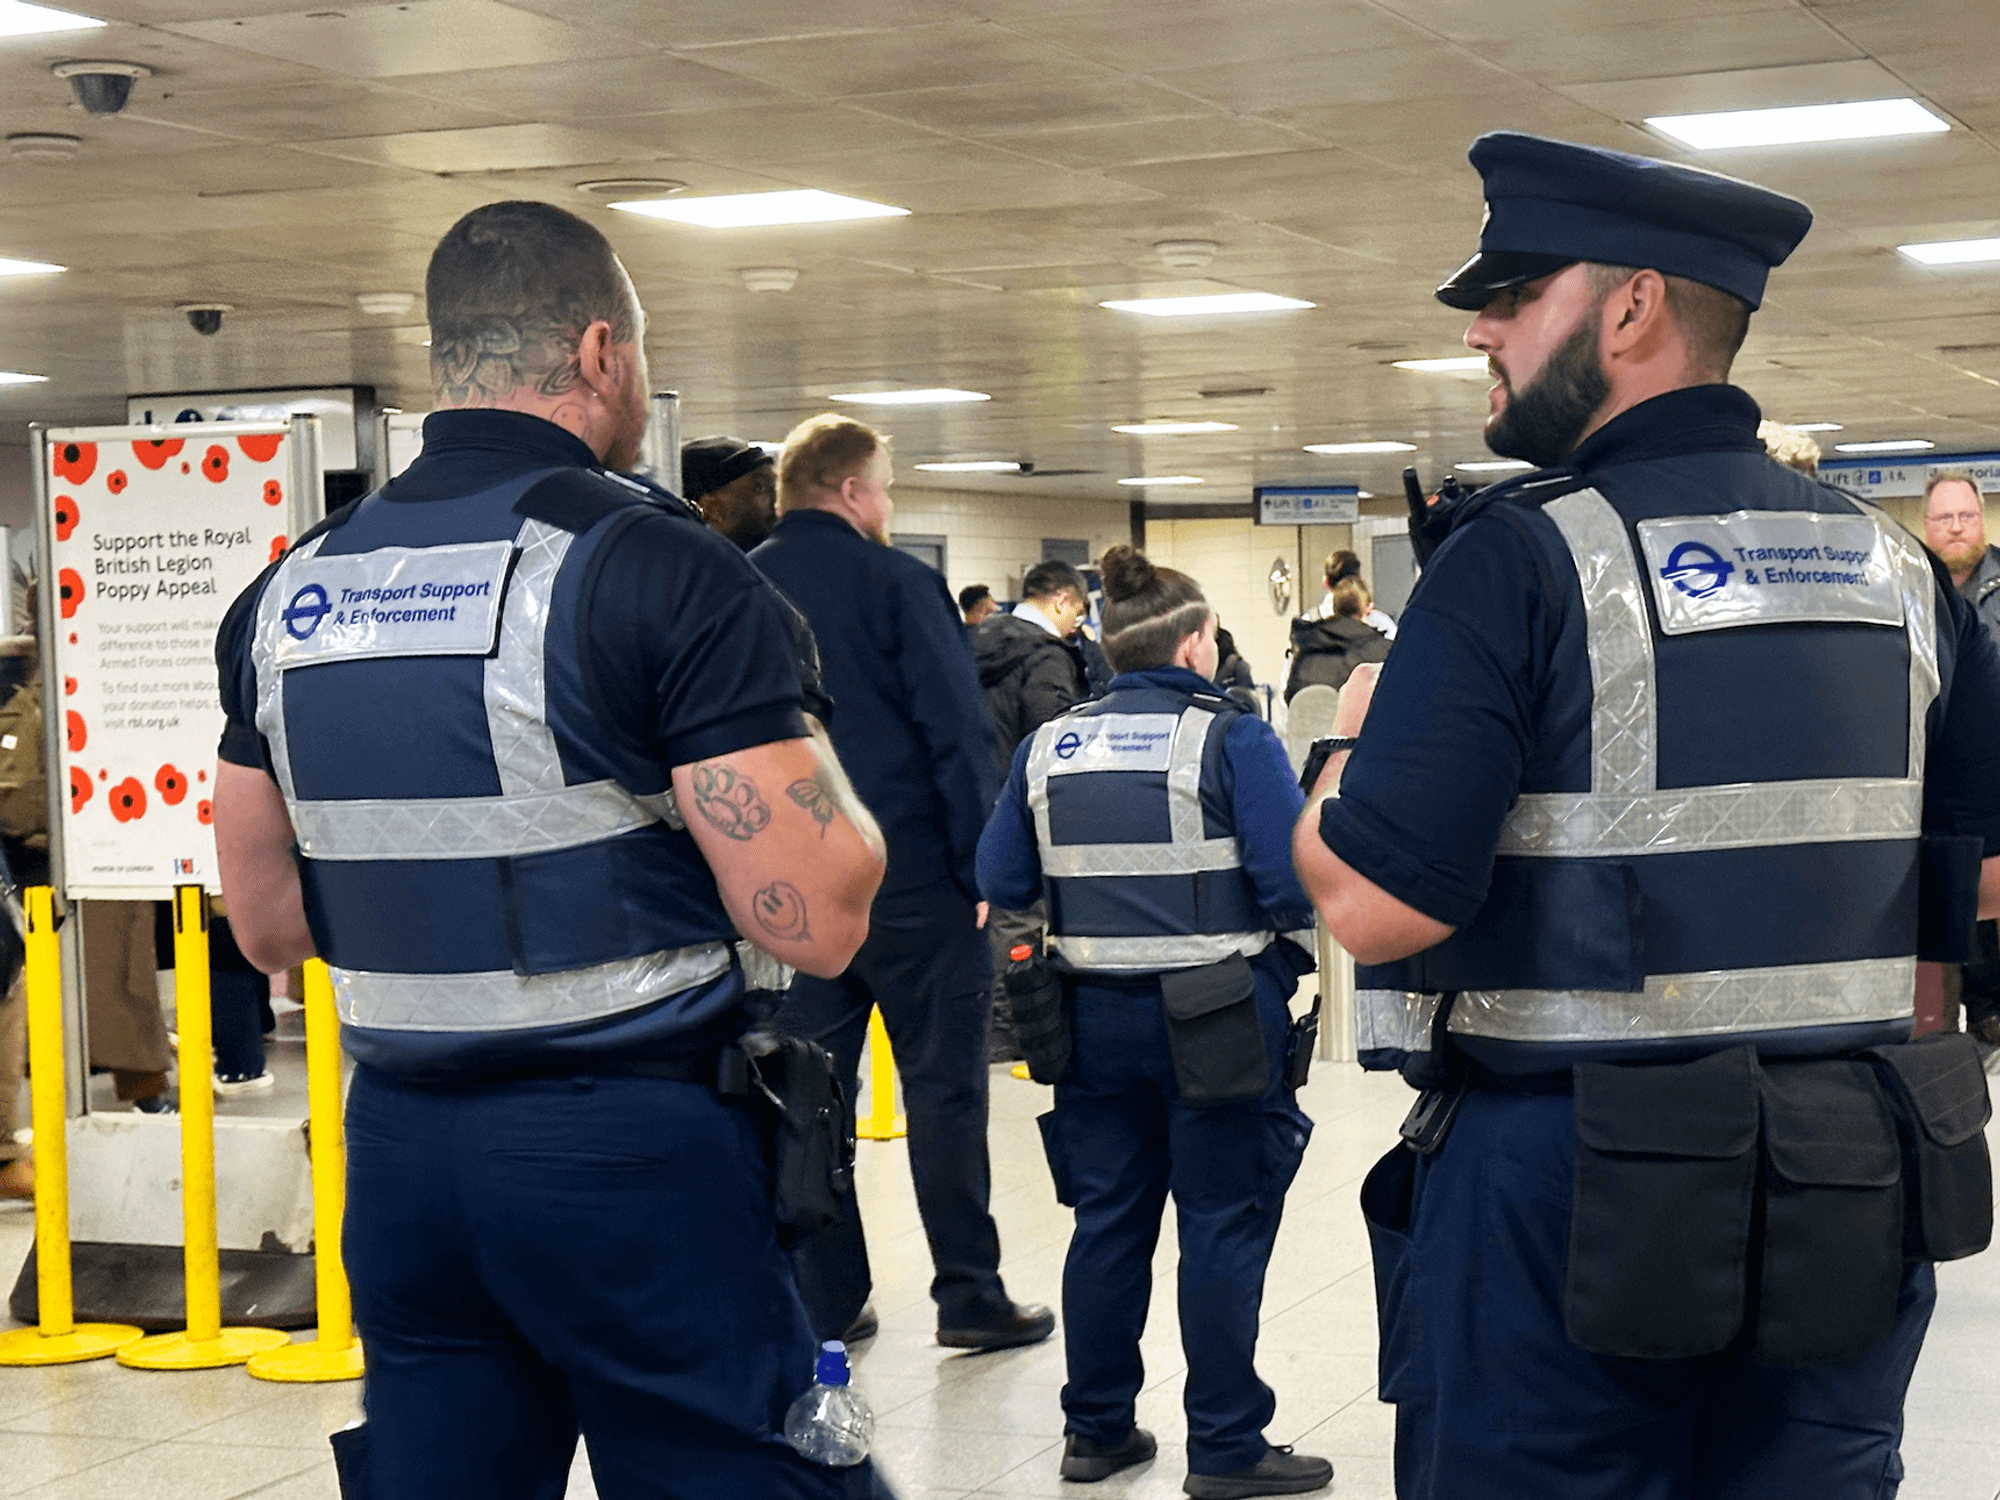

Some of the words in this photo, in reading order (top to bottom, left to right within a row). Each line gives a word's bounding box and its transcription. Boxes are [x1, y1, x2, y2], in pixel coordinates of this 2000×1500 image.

[93, 532, 164, 554] Support
[169, 530, 198, 548] the
[204, 526, 252, 549] Royal
[95, 555, 150, 575] British
[156, 554, 212, 575] Legion
[1734, 545, 1820, 564] Transport
[1825, 546, 1872, 566] Suppo
[1746, 568, 1759, 585] &
[1766, 566, 1869, 586] Enforcement
[96, 581, 150, 601] Poppy
[156, 577, 217, 599] Appeal
[340, 584, 417, 604] Transport
[419, 580, 491, 602] Support
[333, 610, 345, 625] &
[350, 605, 456, 625] Enforcement
[97, 622, 123, 635] Your
[125, 620, 168, 635] support
[98, 639, 154, 651] difference
[155, 638, 168, 650] to
[170, 637, 200, 649] those
[99, 657, 137, 669] Armed
[139, 655, 174, 668] Forces
[101, 681, 114, 694] To
[116, 680, 138, 694] find
[140, 681, 159, 693] out
[161, 681, 190, 693] more
[192, 680, 218, 692] abou
[101, 701, 127, 715] your
[129, 699, 177, 712] donation
[127, 715, 180, 731] rbl.org.uk
[1131, 731, 1170, 742] Support
